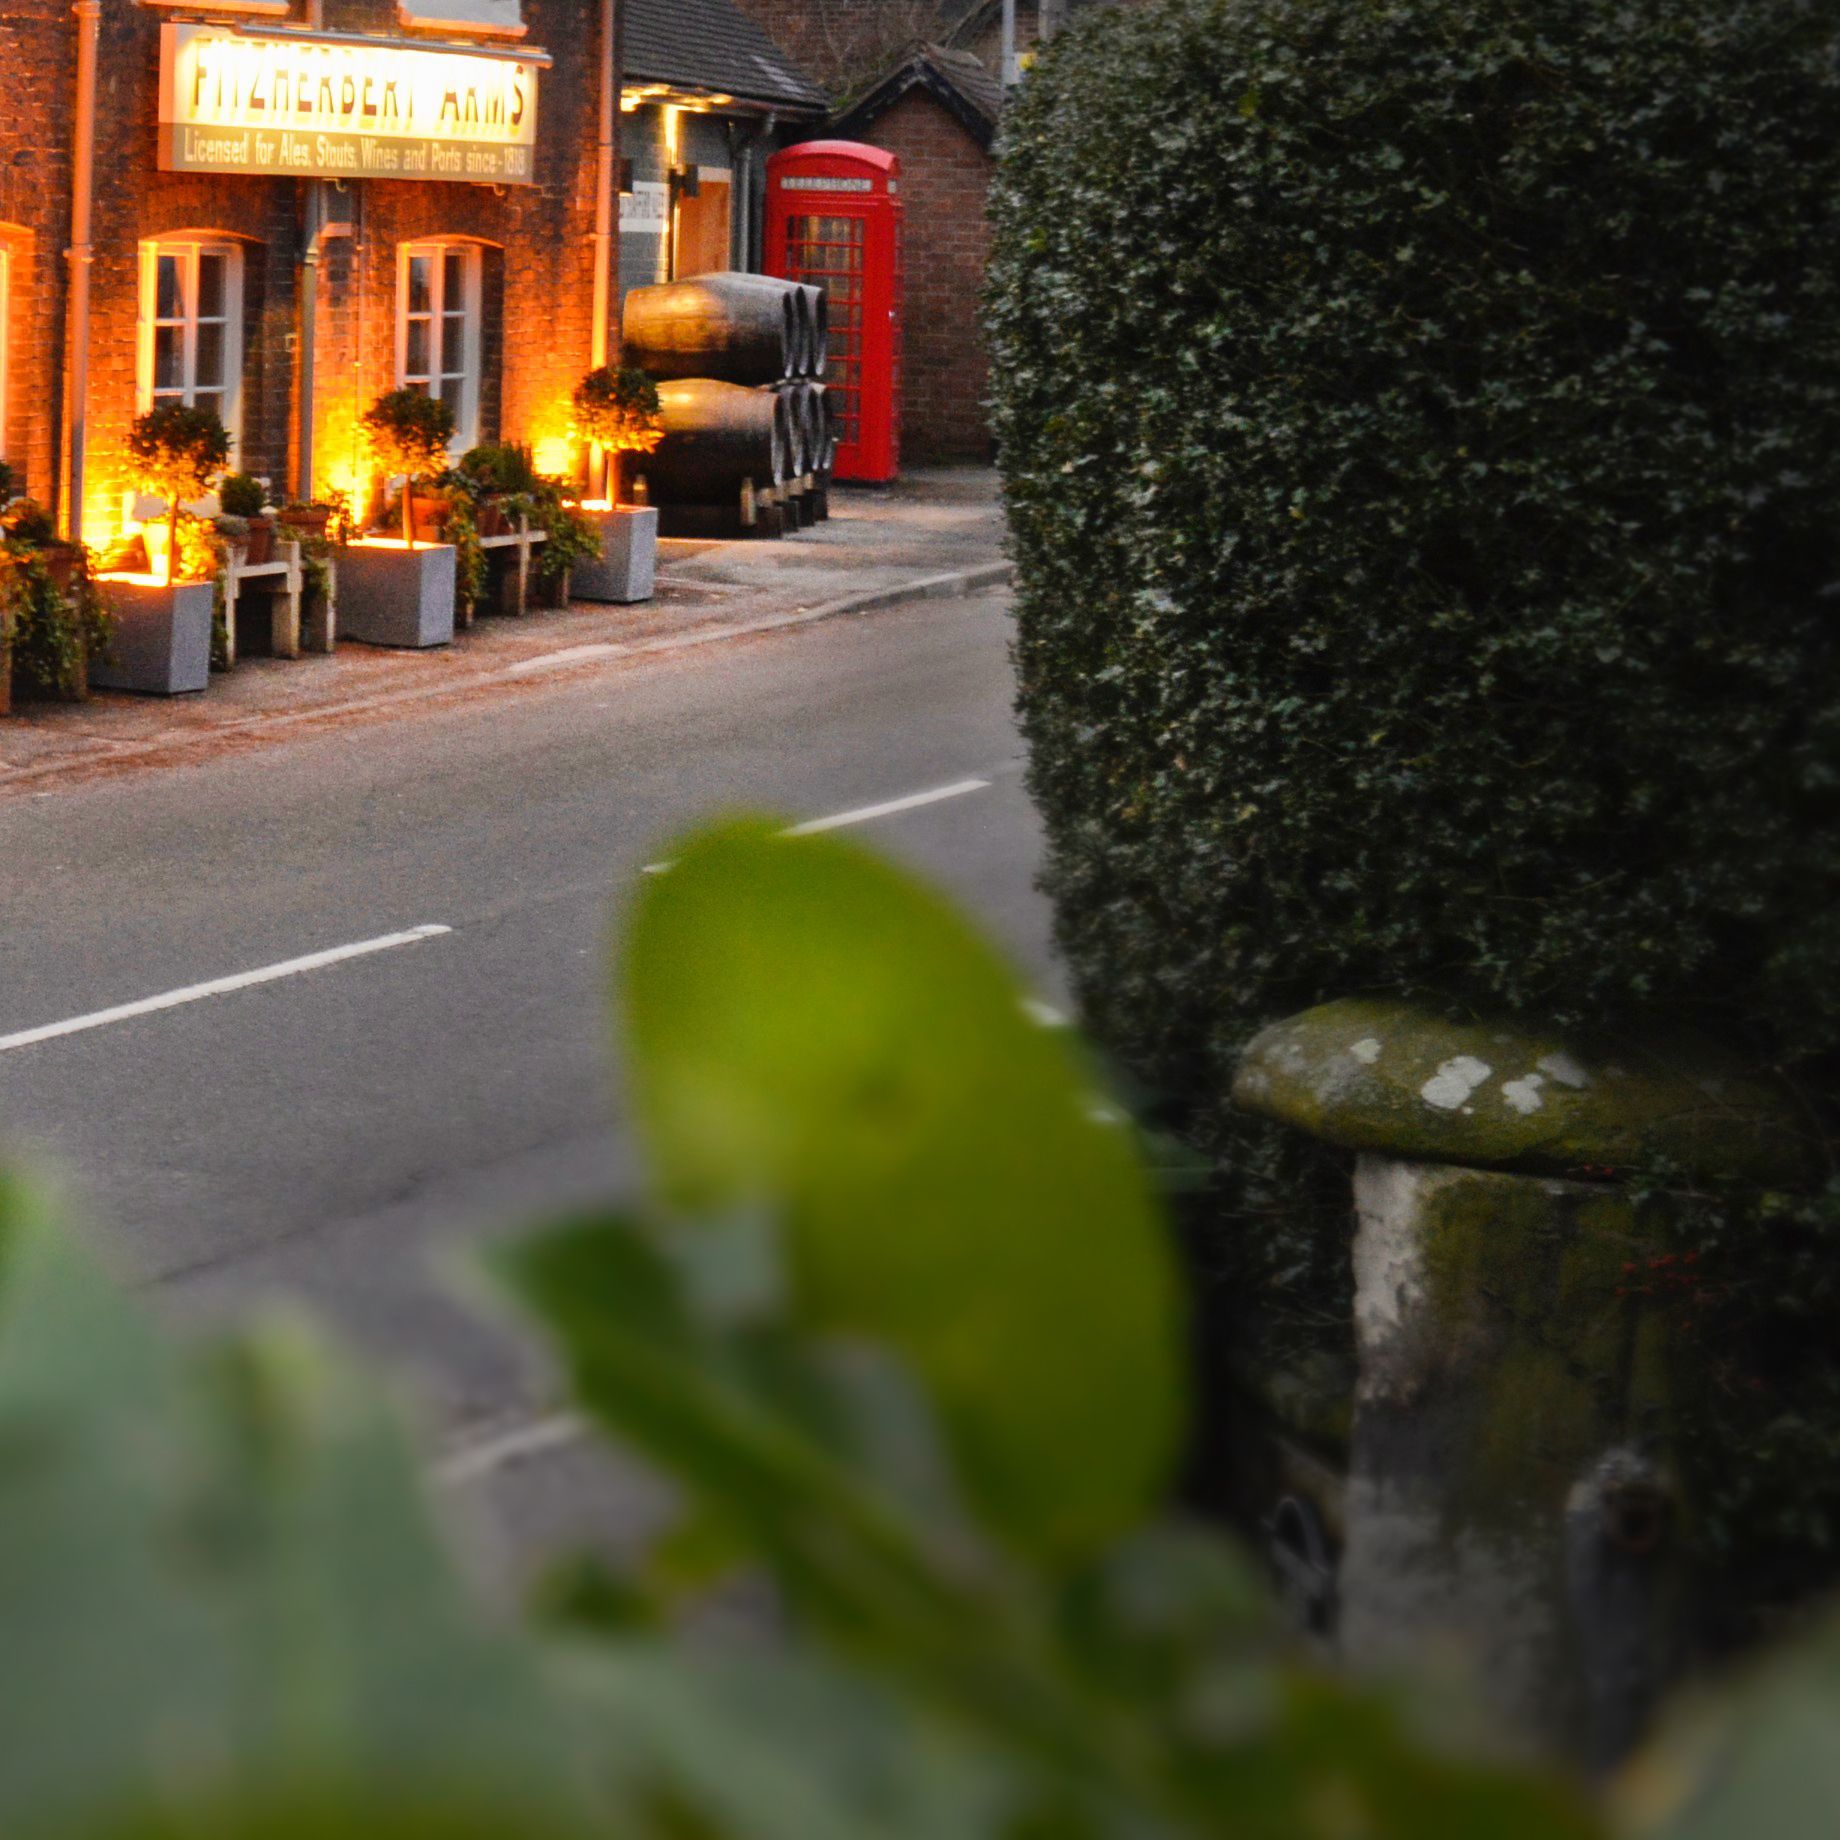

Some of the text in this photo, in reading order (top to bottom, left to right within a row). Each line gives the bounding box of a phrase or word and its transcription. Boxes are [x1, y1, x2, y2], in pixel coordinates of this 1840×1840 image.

[440, 58, 525, 126] ARMS
[184, 127, 249, 164] Licensed
[255, 131, 274, 165] for
[361, 137, 398, 170] Wines
[403, 142, 427, 171] and
[431, 142, 462, 172] Ports
